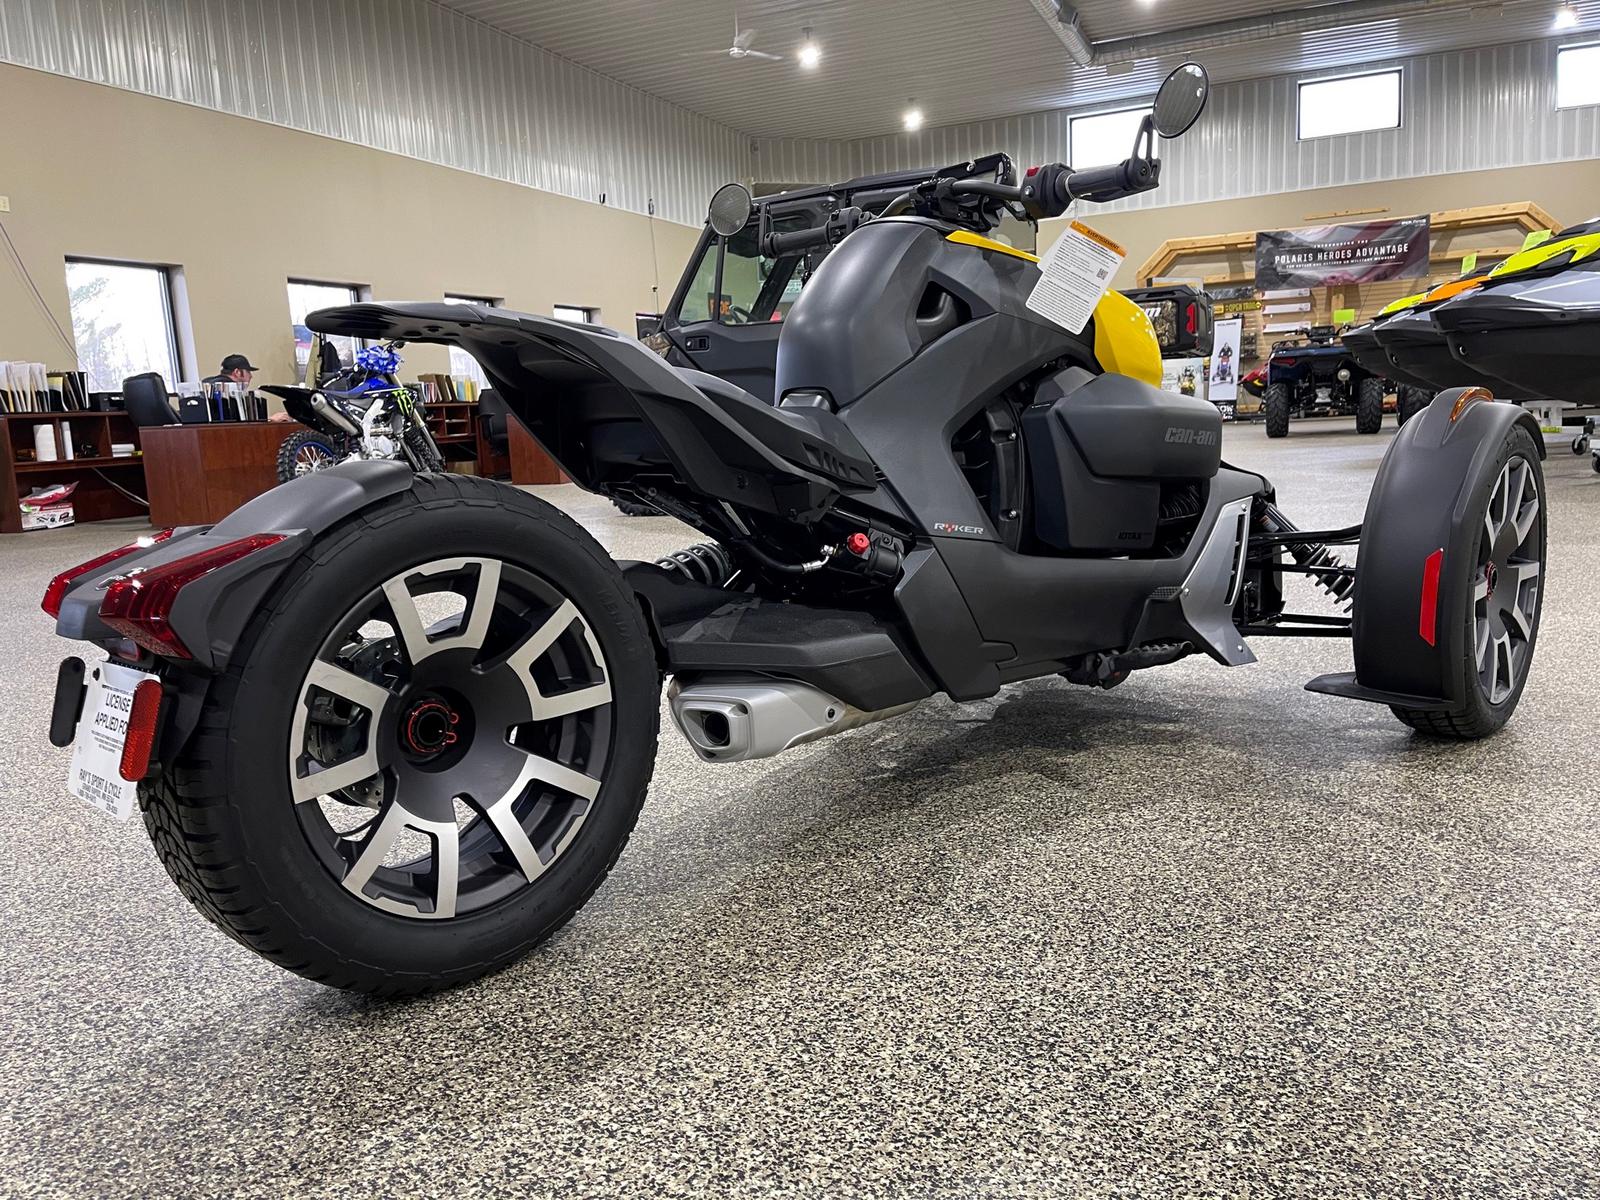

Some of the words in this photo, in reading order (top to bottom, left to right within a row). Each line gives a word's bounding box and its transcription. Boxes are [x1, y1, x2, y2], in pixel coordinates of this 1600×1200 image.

[1275, 253, 1313, 264] POLARIS
[1318, 249, 1352, 261] HEROES
[1356, 243, 1409, 257] ADVANTAGE
[1164, 427, 1217, 446] can-am
[934, 522, 984, 535] RYKER
[105, 693, 131, 713] LICENSE
[95, 713, 119, 733] APPLIED
[118, 721, 128, 735] FO
[90, 772, 105, 790] SPORT
